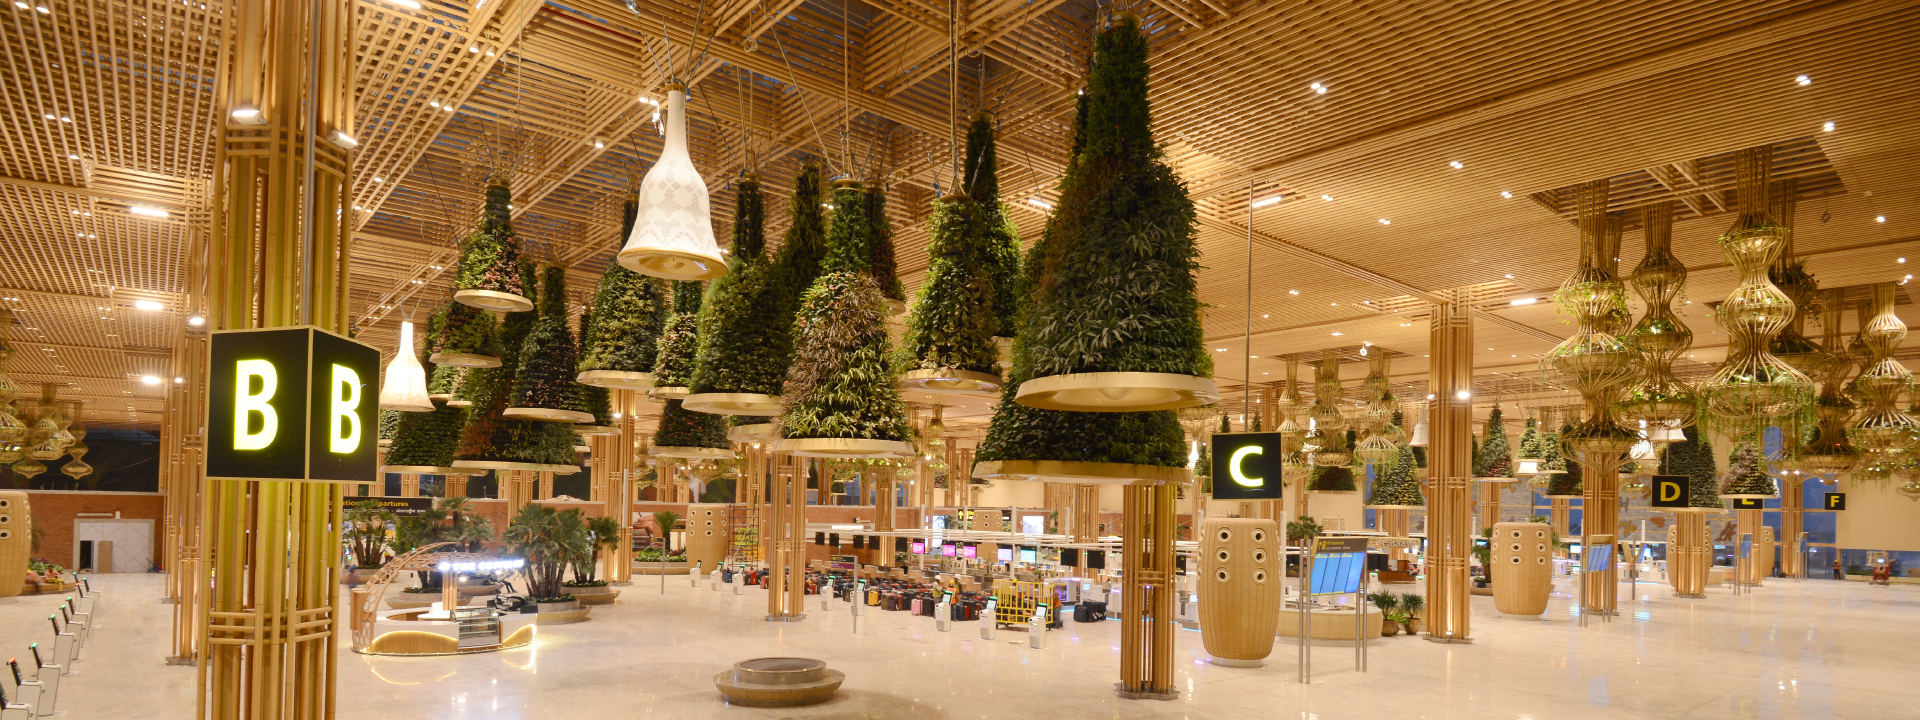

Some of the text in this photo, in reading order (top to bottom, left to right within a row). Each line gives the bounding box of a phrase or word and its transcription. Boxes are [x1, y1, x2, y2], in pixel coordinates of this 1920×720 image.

[233, 358, 279, 451] B
[329, 362, 362, 454] B
[1228, 445, 1264, 488] C
[371, 500, 409, 508] partures
[1659, 481, 1681, 502] D
[1830, 495, 1840, 508] F
